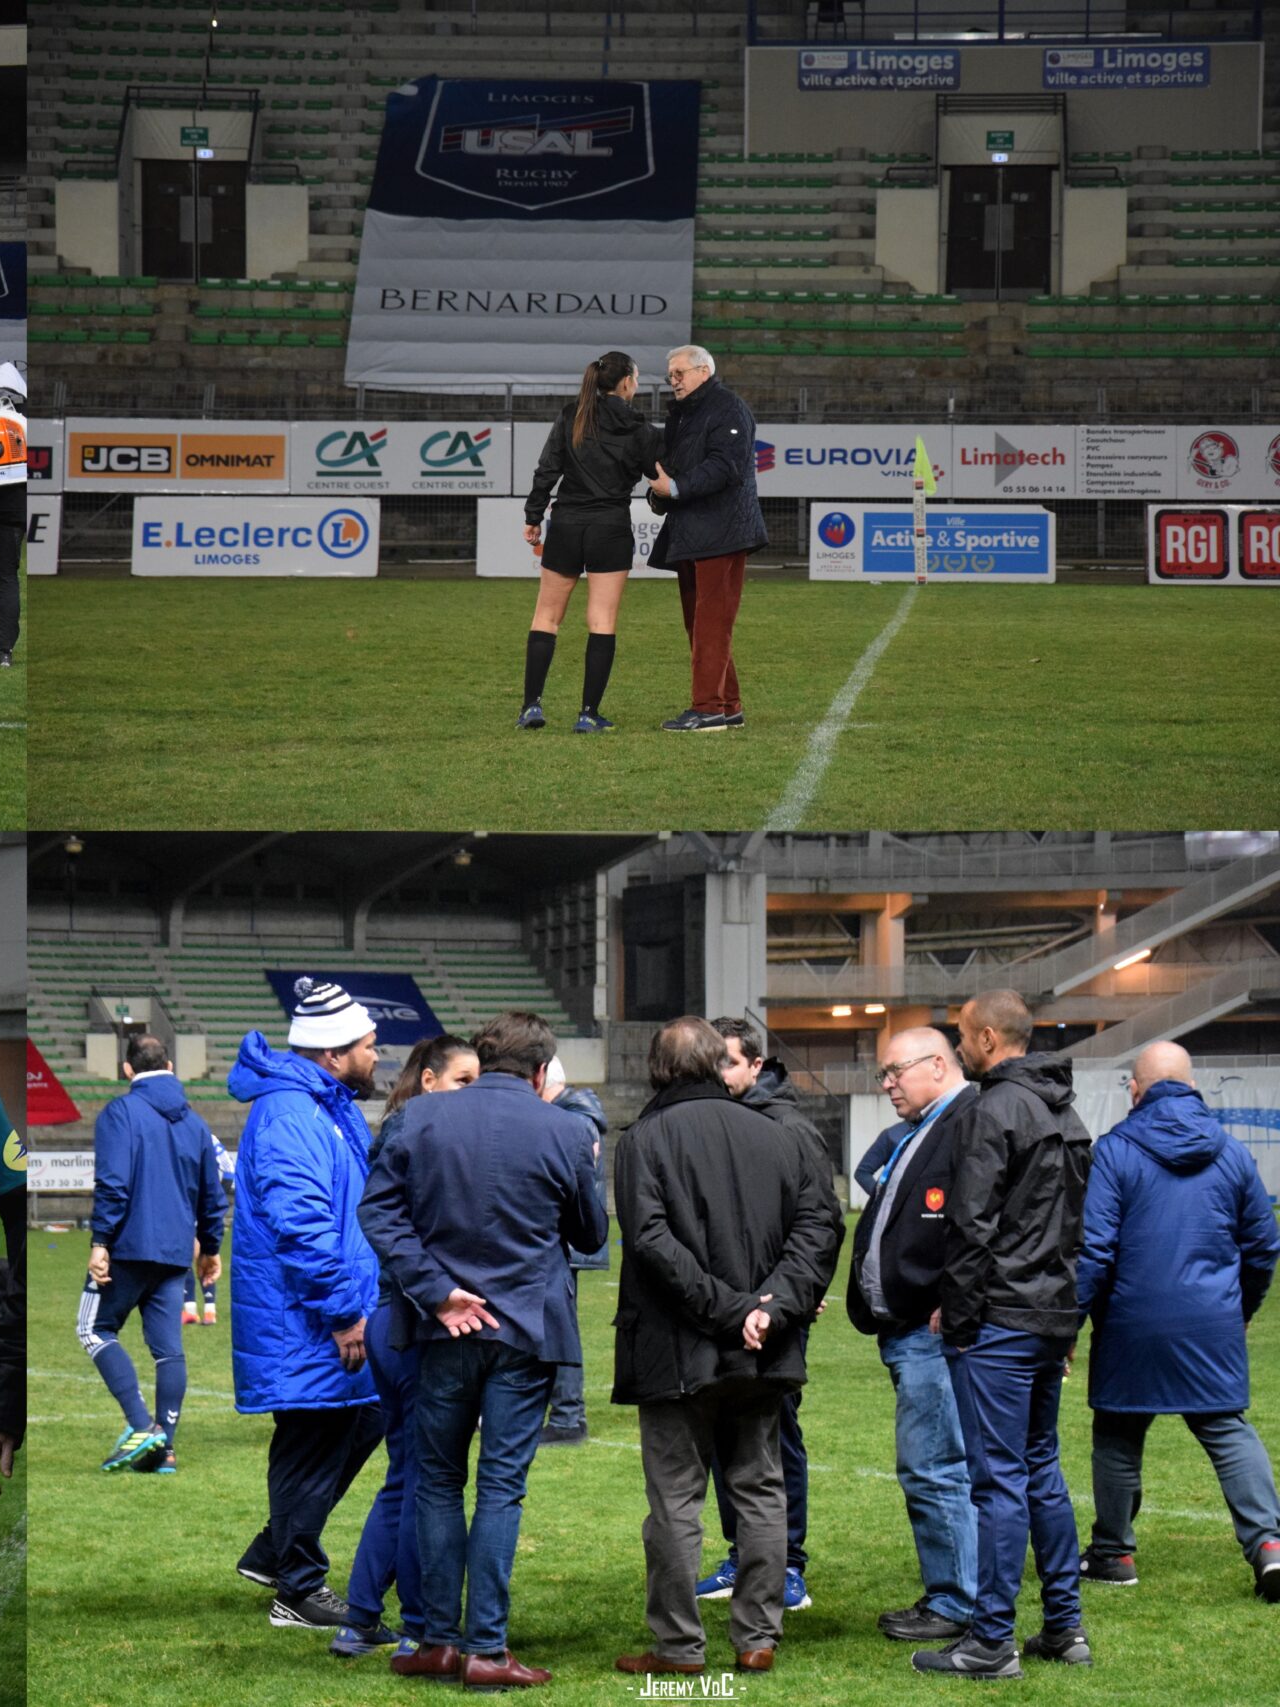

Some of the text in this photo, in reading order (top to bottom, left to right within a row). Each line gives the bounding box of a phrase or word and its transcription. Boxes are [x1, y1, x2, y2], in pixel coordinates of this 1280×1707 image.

[856, 51, 955, 74] Limoges
[1102, 49, 1204, 71] Limoges
[801, 74, 955, 88] ville active et sportive
[1047, 71, 1204, 86] ville active et sportive
[487, 92, 595, 104] LIMOGES
[461, 128, 613, 156] USAL
[495, 168, 579, 180] RUGBY
[379, 288, 668, 316] BERNARDAUD
[81, 446, 275, 473] JCB OMNIMAT
[960, 447, 1066, 466] Limatech
[307, 481, 391, 490] CENTRE OUEST
[412, 480, 495, 489] CENTRE OUEST
[946, 517, 966, 527] Ville
[142, 521, 313, 548] E.Leclerc
[937, 531, 951, 547] &
[954, 529, 1040, 551] Sportive
[1166, 525, 1218, 564] RGI
[194, 552, 261, 566] LIMOGES
[816, 552, 856, 560] LIMOGES
